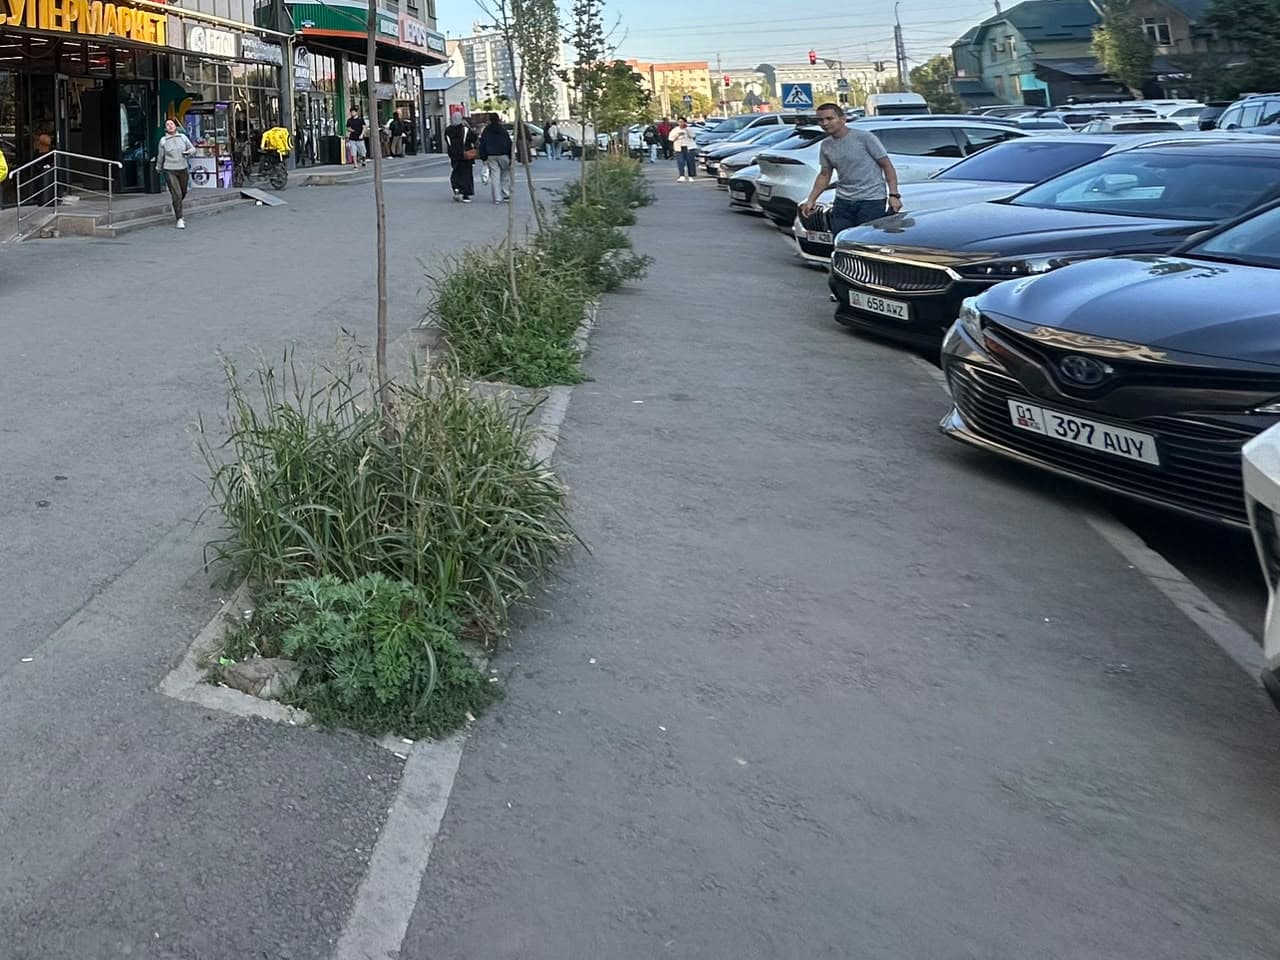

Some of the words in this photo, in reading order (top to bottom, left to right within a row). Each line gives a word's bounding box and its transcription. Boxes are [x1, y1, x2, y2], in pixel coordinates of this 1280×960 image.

[867, 297, 885, 312] 658
[1016, 405, 1035, 421] 01
[1052, 415, 1095, 445] 397
[1103, 431, 1143, 458] AUY
